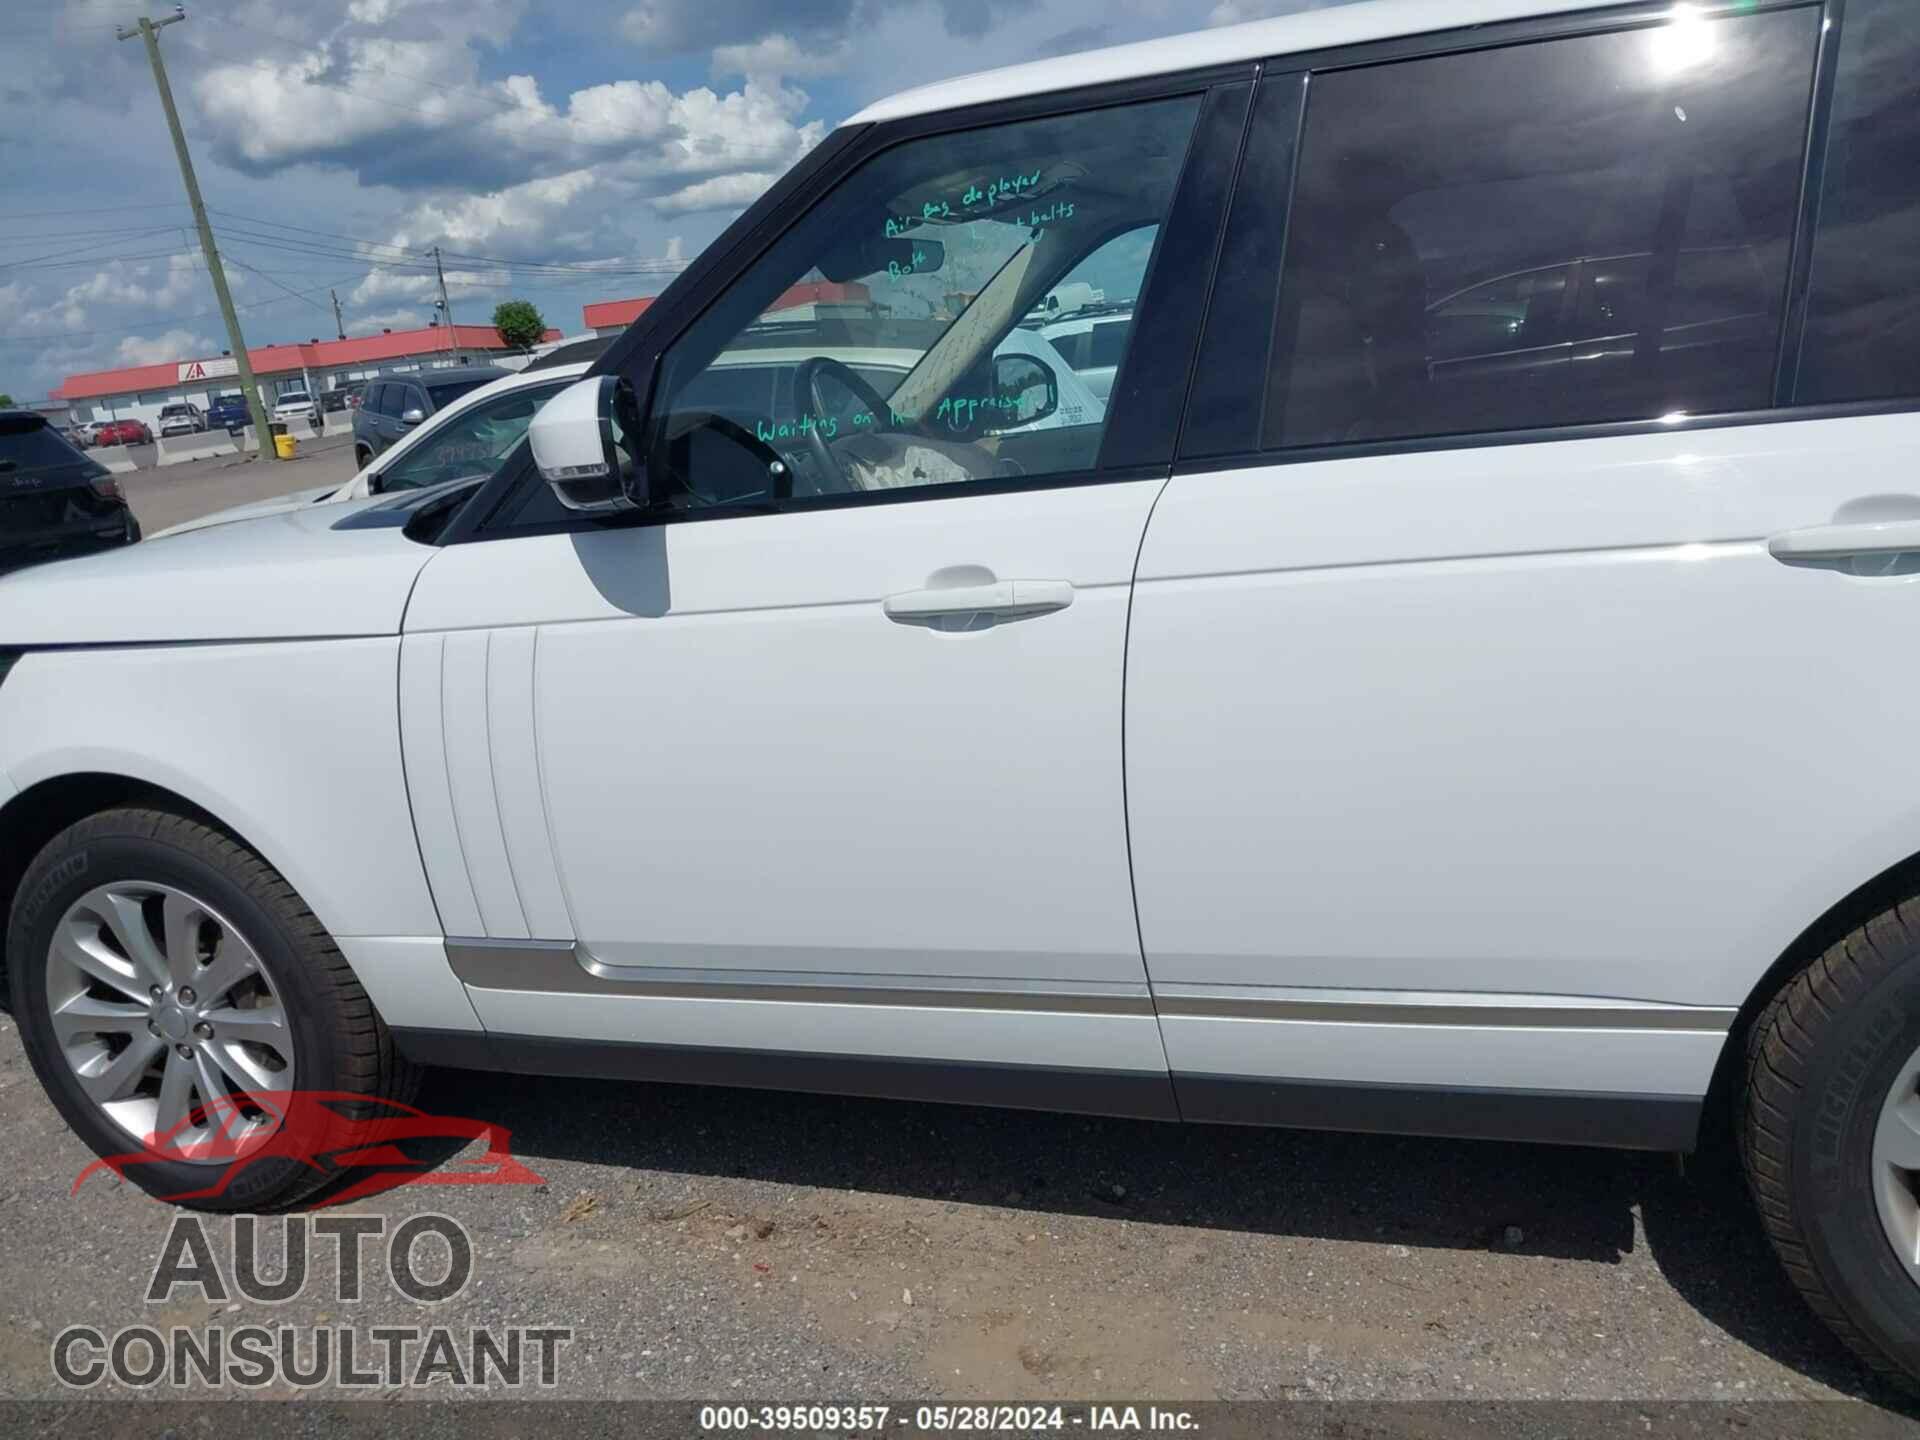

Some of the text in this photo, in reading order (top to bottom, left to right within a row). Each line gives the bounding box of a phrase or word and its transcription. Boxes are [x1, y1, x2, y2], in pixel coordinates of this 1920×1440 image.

[885, 216, 911, 238] Air
[757, 414, 838, 443] Waiting
[853, 413, 873, 425] on
